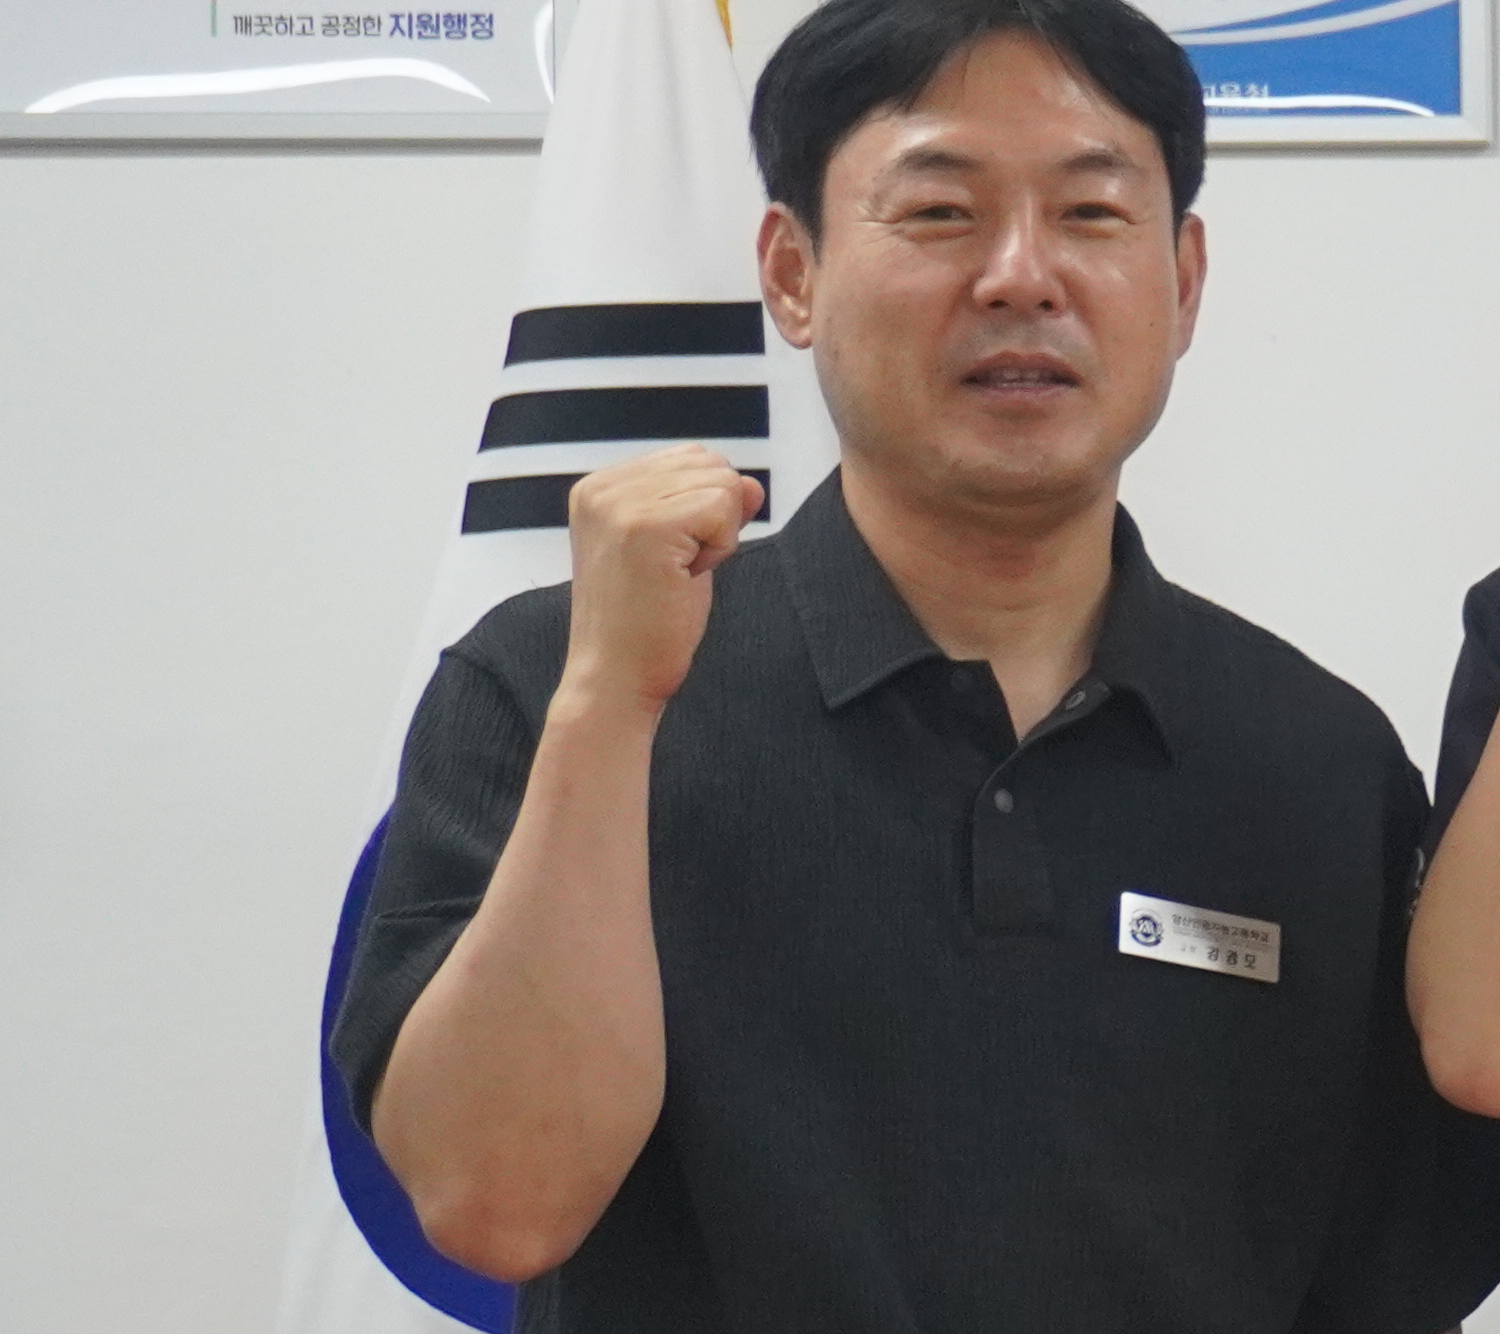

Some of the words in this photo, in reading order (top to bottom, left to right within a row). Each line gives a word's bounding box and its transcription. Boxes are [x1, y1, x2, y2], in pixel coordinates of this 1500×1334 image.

[233, 14, 314, 37] 깨끗하고
[320, 14, 383, 37] 공정한
[389, 11, 494, 42] 지원행정
